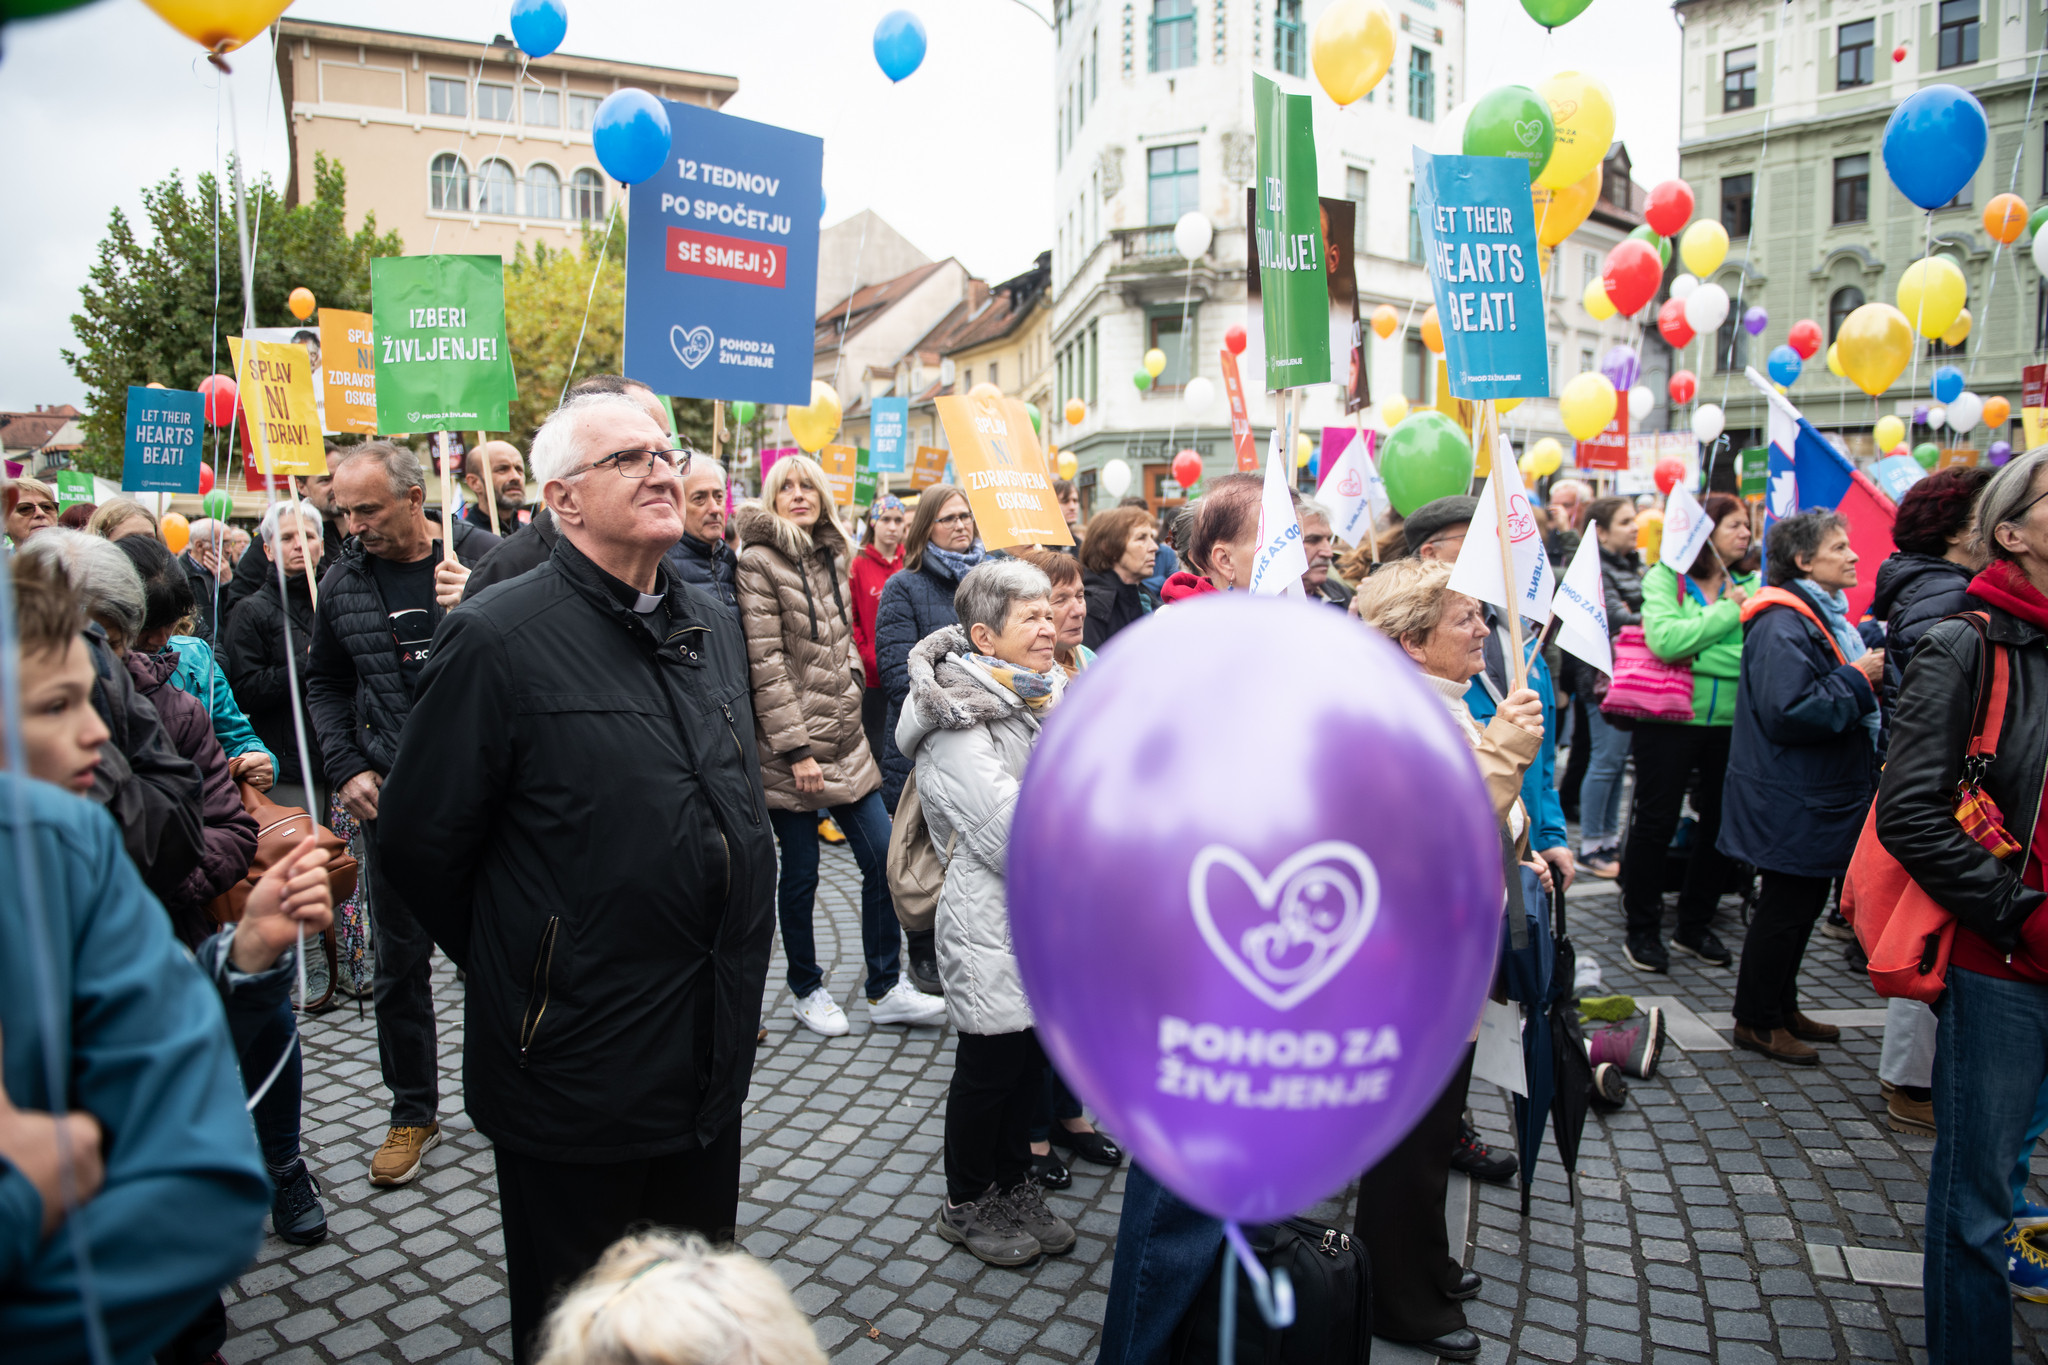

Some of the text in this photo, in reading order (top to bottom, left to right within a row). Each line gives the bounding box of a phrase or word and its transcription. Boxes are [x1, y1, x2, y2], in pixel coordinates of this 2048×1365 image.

[677, 158, 780, 197] 12 TEDNOV
[661, 192, 791, 235] PO SPOČETJU
[1432, 203, 1514, 234] LET THEIR
[678, 241, 777, 279] SE SMEJI :)
[1433, 239, 1525, 284] HEARTS
[409, 307, 467, 329] IZBERI
[1447, 291, 1517, 333] BEAT!
[357, 348, 374, 370] NI
[382, 335, 498, 364] ŽIVLJENJE!
[719, 337, 775, 355] POHOD ZA
[719, 350, 774, 369] ŽIVLJENJE
[248, 359, 292, 384] SPLAV
[141, 408, 191, 425] LET THEIR
[264, 385, 290, 420] NI
[135, 424, 194, 446] HEARTS
[142, 446, 184, 466] BEAT!
[1580, 600, 1595, 615] ZA
[1160, 1016, 1402, 1066] POHOD ZA
[1157, 1053, 1392, 1108] ŽIVLJENJE
